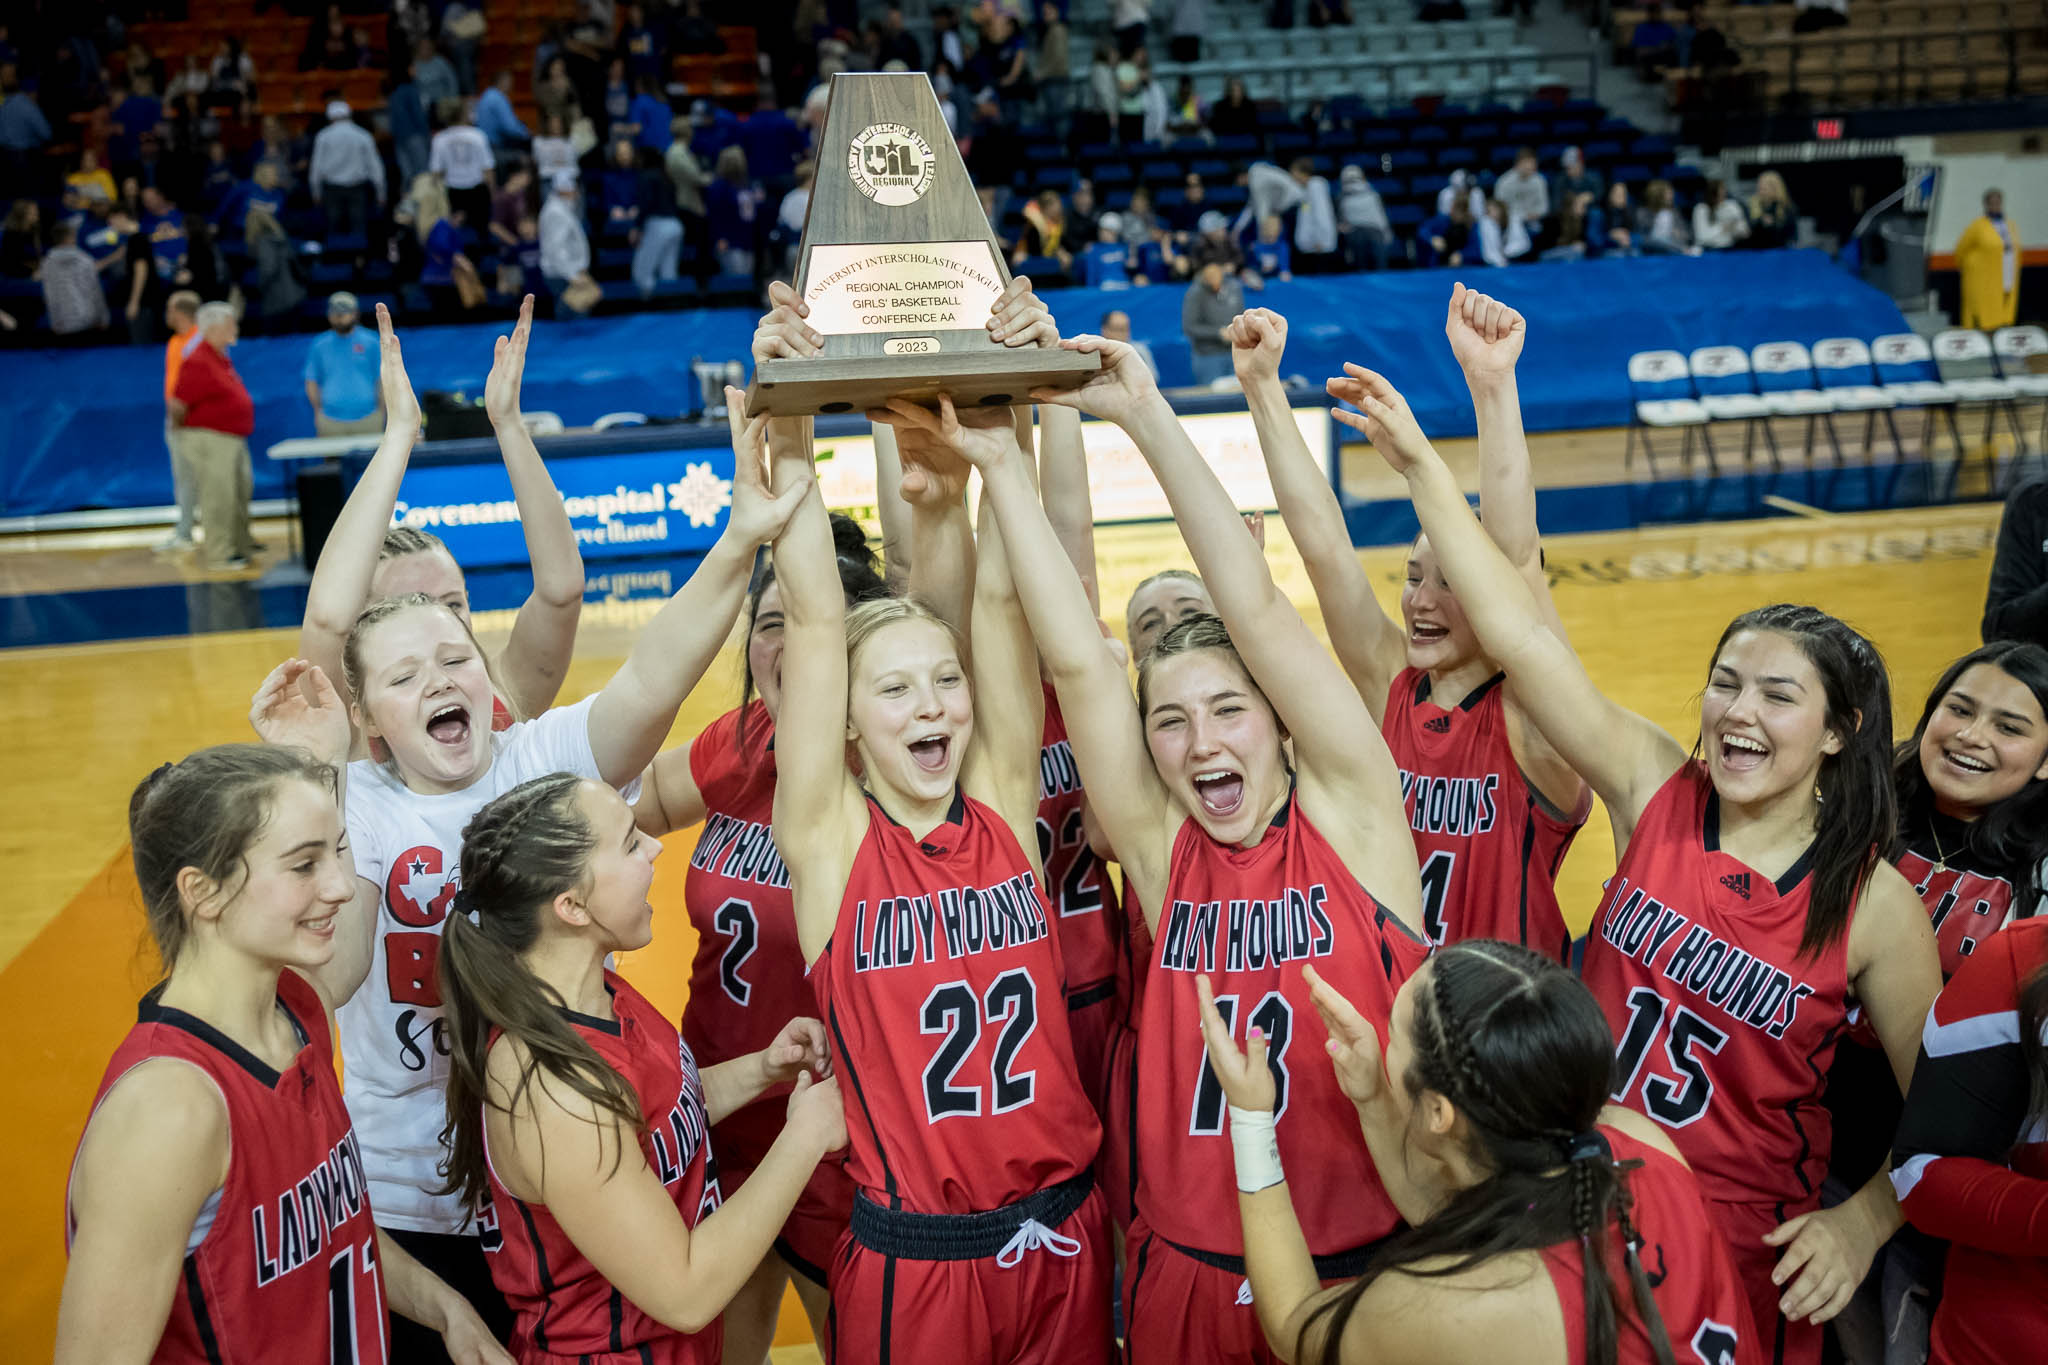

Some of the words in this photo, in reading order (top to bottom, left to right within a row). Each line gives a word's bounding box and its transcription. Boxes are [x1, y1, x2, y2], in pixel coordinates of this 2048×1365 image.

[863, 139, 920, 176] UIL
[872, 177, 915, 187] REGIONAL
[808, 260, 863, 300] UNIVERSITY
[865, 253, 962, 272] INTERSCHOLASTIC
[962, 266, 1002, 294] LEAGUE
[846, 282, 902, 293] REGIONAL
[904, 280, 964, 291] CHAMPION
[852, 299, 888, 309] GIRLS'
[891, 296, 961, 308] BASKETBALL
[862, 313, 937, 325] CONFERENCE
[940, 312, 956, 321] AA
[896, 341, 928, 353] 2023
[389, 500, 521, 530] Covenan
[557, 482, 665, 524] ospital
[855, 893, 936, 973] LADY
[938, 870, 1049, 960] HOUNDS
[714, 897, 759, 1007] 2
[1601, 877, 1688, 968] LADY
[1663, 923, 1816, 1040] HOUNDS
[919, 966, 1038, 1126] 22
[1610, 986, 1730, 1129] 15
[253, 1160, 332, 1289] LADY
